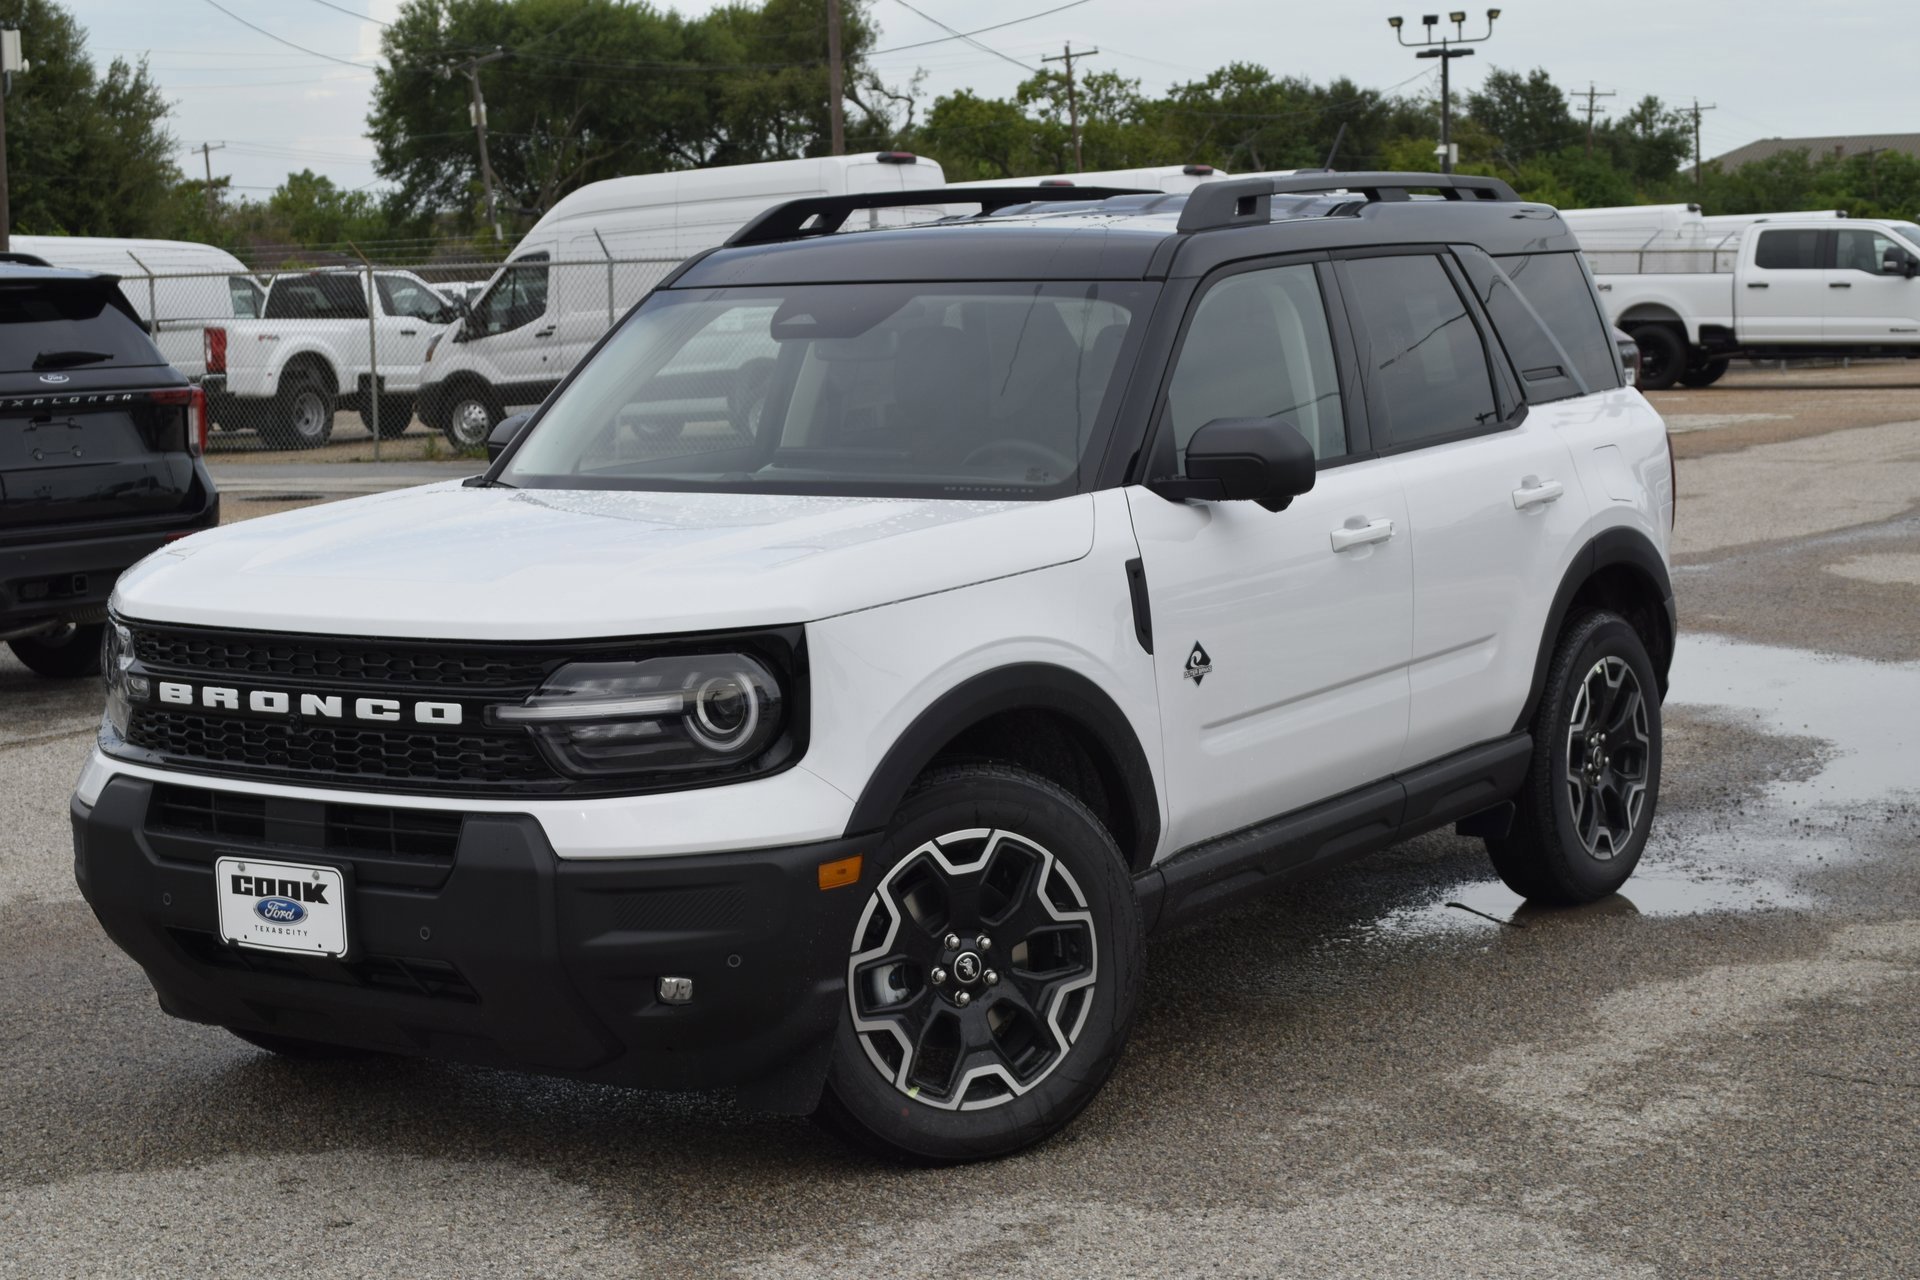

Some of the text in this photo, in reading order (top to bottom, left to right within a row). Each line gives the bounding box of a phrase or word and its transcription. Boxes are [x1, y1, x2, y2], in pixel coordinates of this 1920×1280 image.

[0, 394, 132, 407] XPLORER
[159, 681, 463, 725] BRONCO
[231, 874, 329, 905] COOK
[264, 900, 295, 921] Ford
[255, 925, 308, 937] TEXAS CITY
